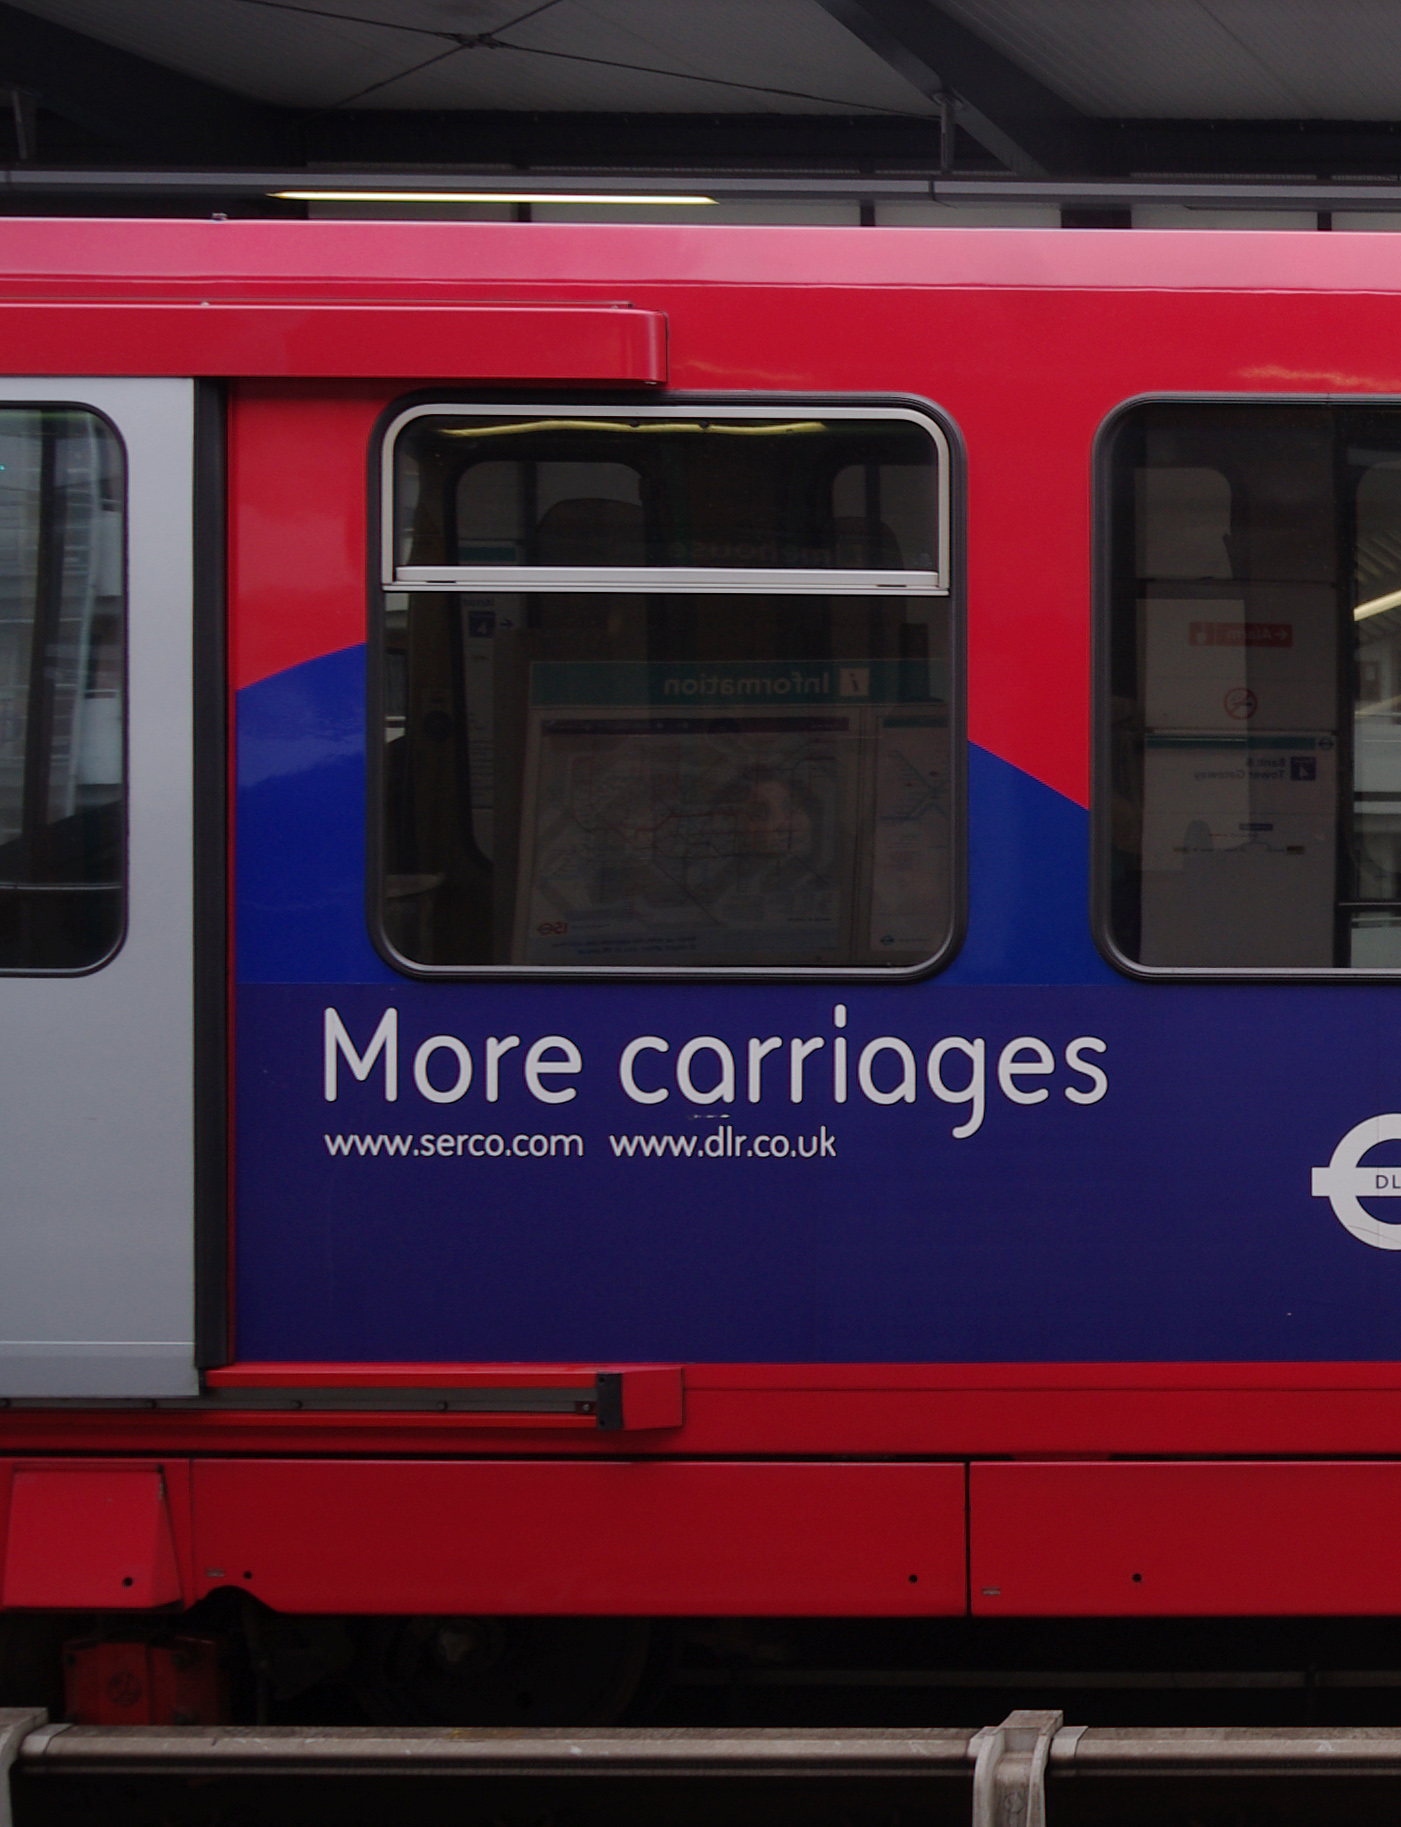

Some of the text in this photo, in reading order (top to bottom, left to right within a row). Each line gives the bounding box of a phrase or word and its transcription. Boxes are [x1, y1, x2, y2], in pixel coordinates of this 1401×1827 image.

[323, 1003, 1109, 1139] More carriages
[324, 1125, 838, 1158] www.serco.com www.dlr.co.uk
